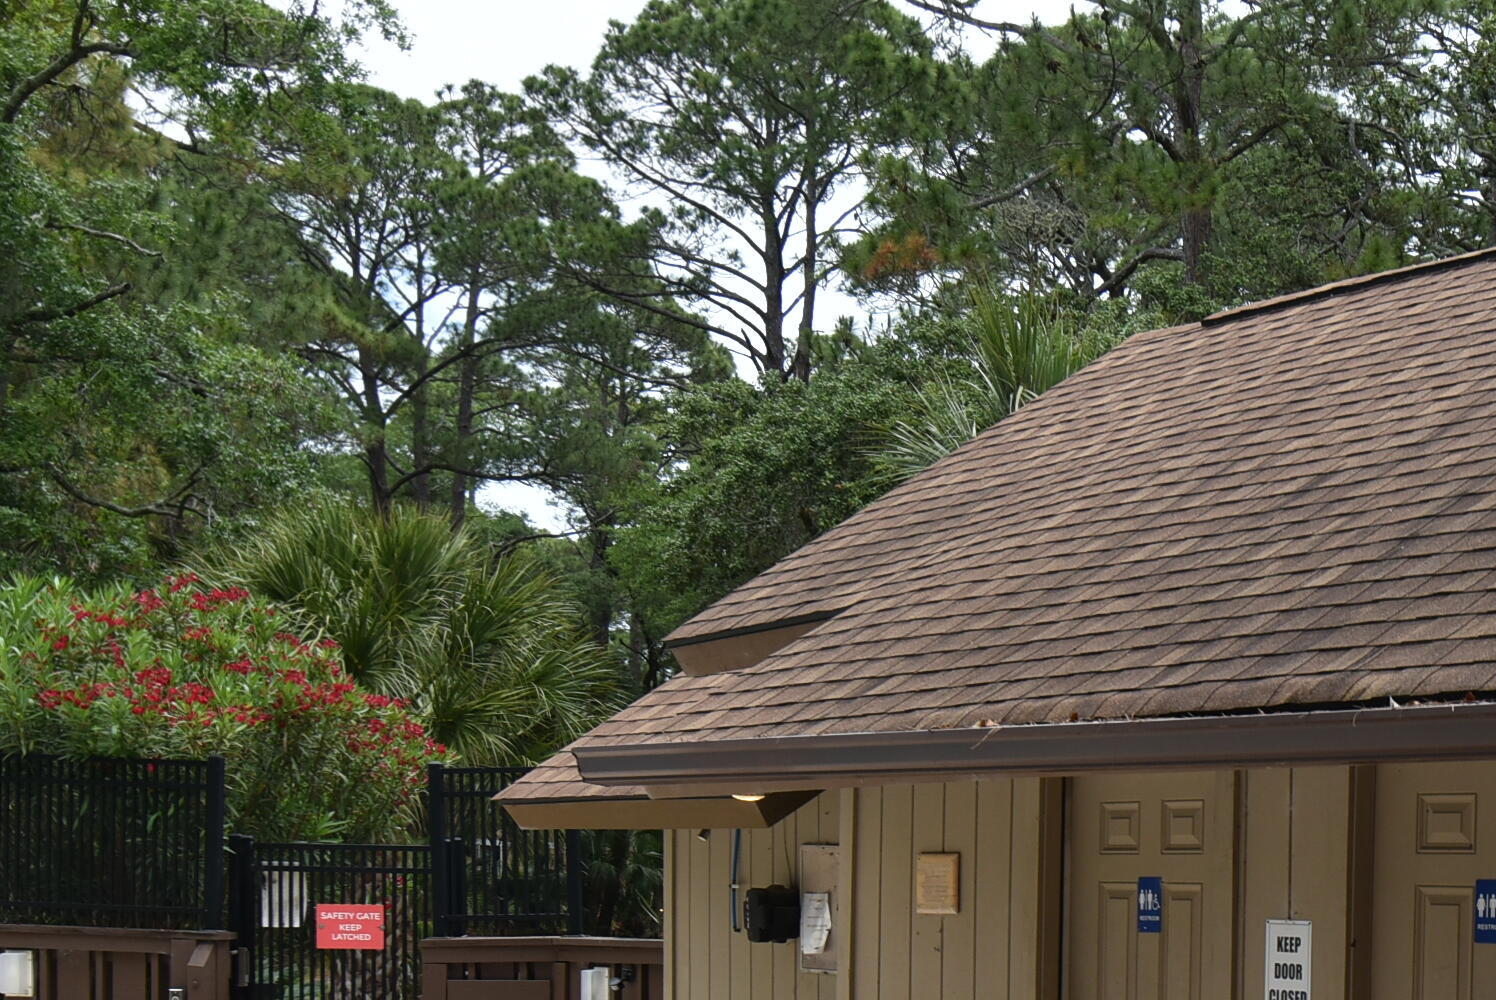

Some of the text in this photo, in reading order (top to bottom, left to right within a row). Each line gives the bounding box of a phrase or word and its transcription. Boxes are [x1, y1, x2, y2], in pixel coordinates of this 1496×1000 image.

[320, 911, 382, 921] SAFETY GATE
[339, 923, 362, 932] KEEP
[331, 933, 372, 941] LATCHED
[1276, 936, 1302, 954] KEEP
[1274, 962, 1303, 981] DOOR
